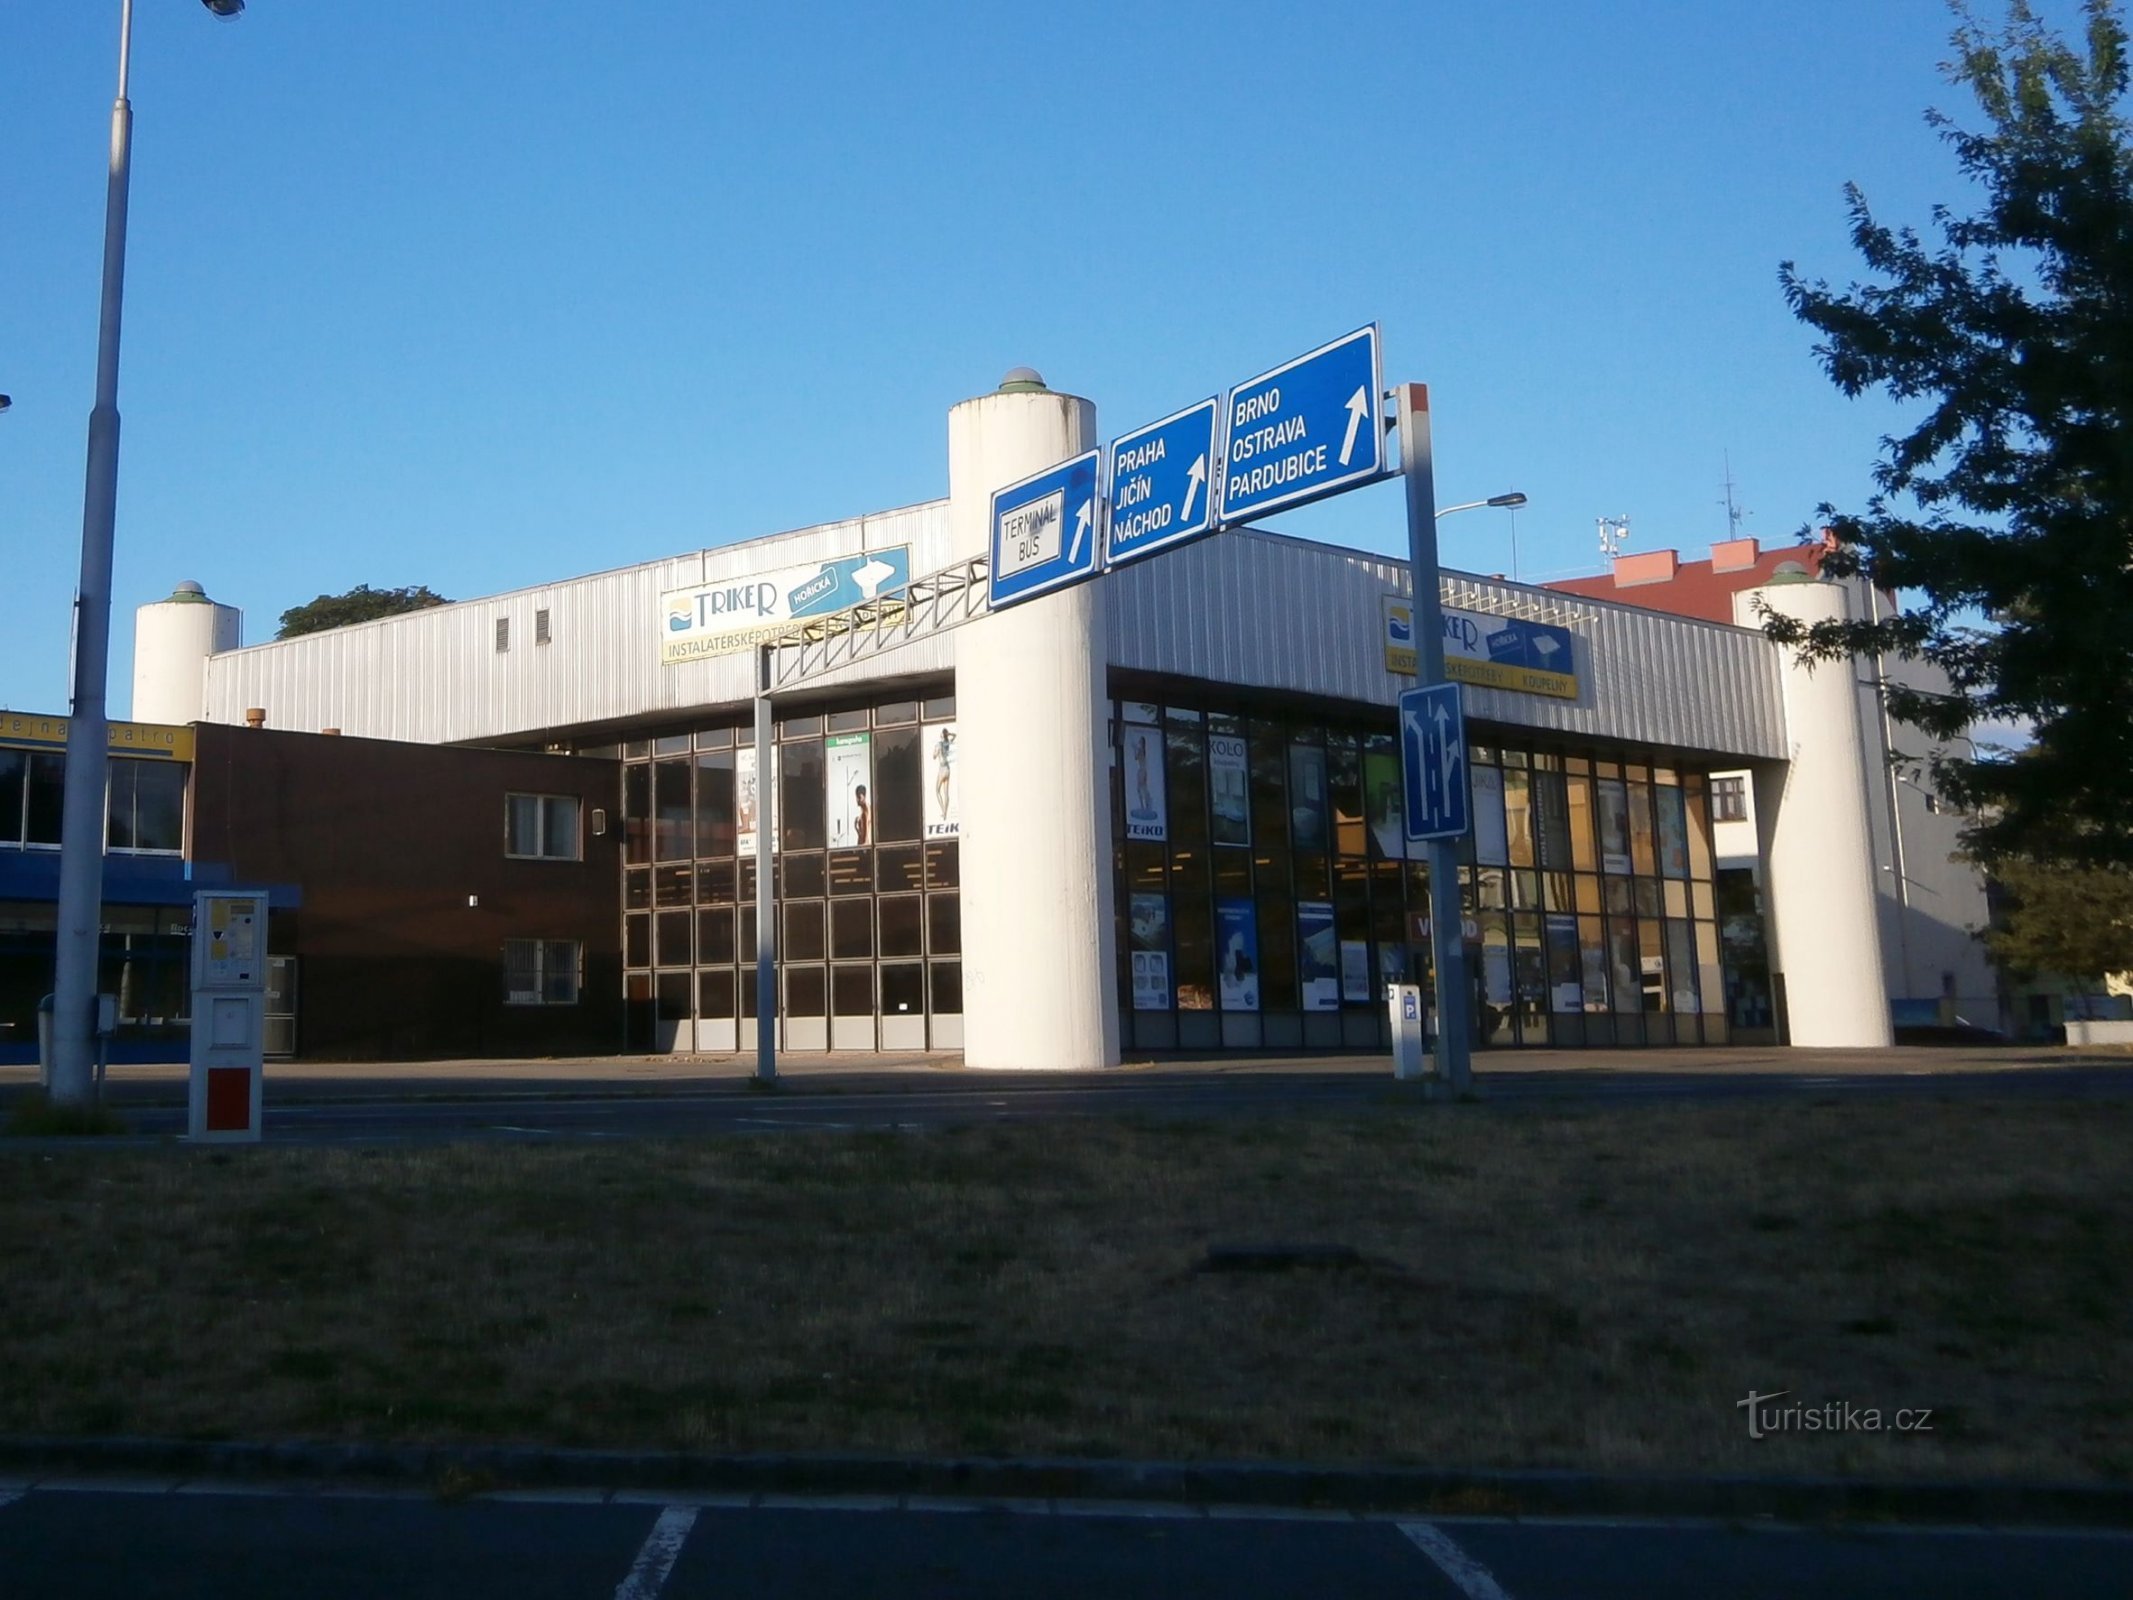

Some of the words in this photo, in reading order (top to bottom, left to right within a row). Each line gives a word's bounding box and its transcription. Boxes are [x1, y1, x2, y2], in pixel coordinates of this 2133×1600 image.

[1235, 388, 1280, 427] BRNO
[1117, 438, 1165, 477] PRAHA
[1233, 415, 1307, 463] OSTRAVA
[1115, 474, 1151, 510] JIČÍN
[1229, 445, 1328, 501] PARDUBICE
[1004, 501, 1057, 541] TERMINÁL
[1113, 503, 1171, 545] NÁCHOD
[1018, 536, 1040, 562] BUS
[694, 582, 777, 627] TRIKER
